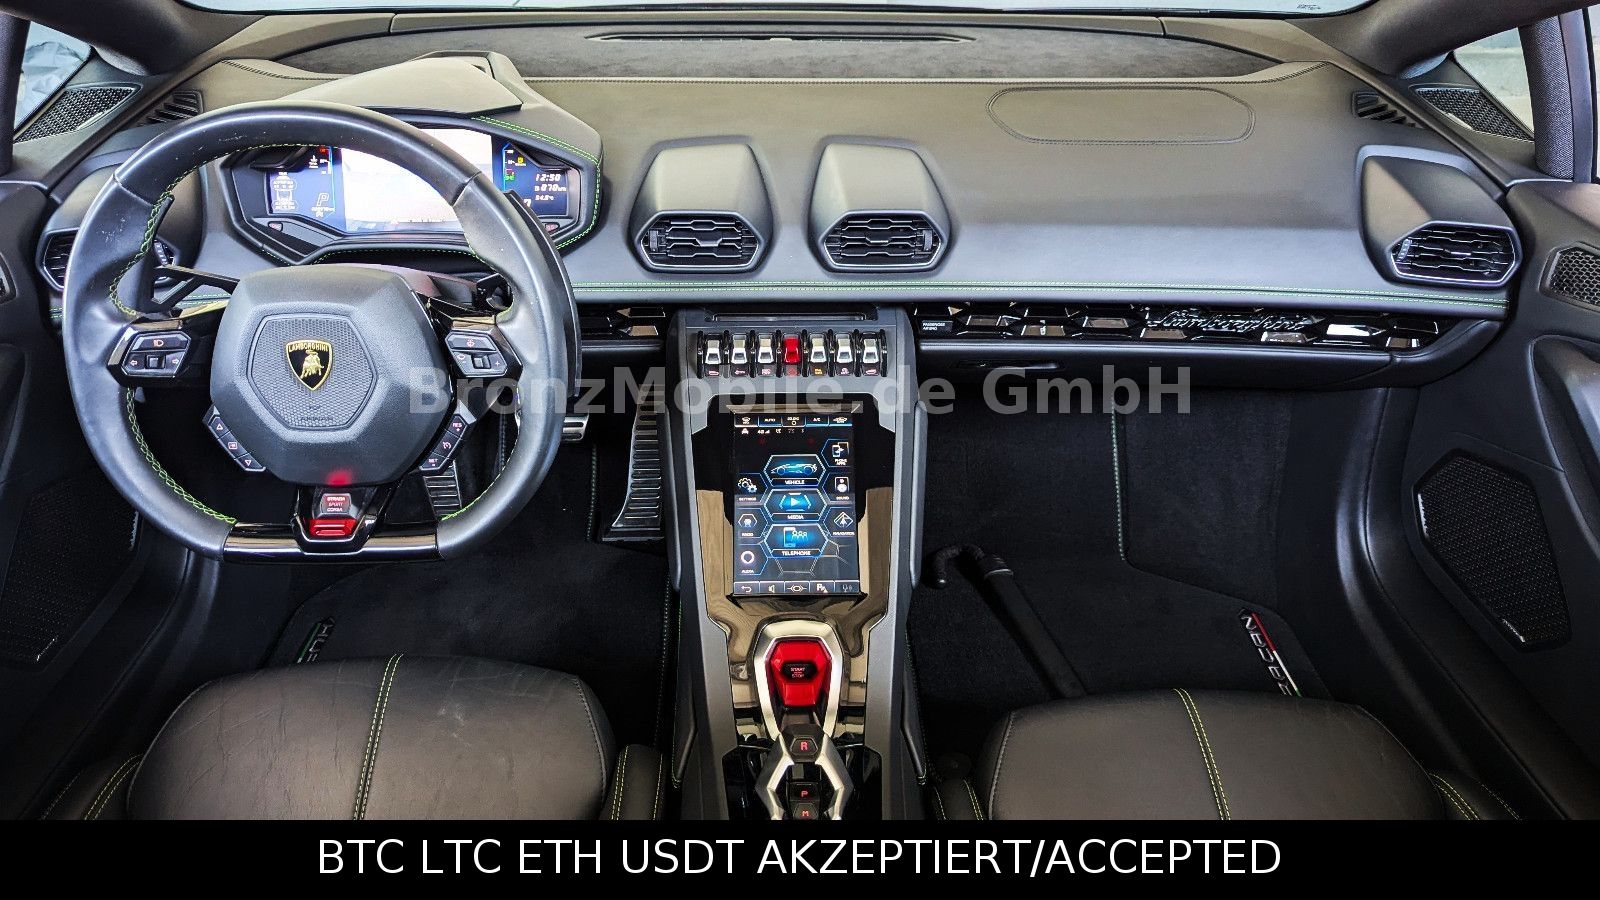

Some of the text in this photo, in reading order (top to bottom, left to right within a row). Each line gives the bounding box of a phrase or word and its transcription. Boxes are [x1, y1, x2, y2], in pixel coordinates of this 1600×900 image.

[288, 342, 329, 353] LAMBORGHINI
[800, 741, 808, 750] R
[801, 790, 808, 798] P
[802, 809, 810, 817] M
